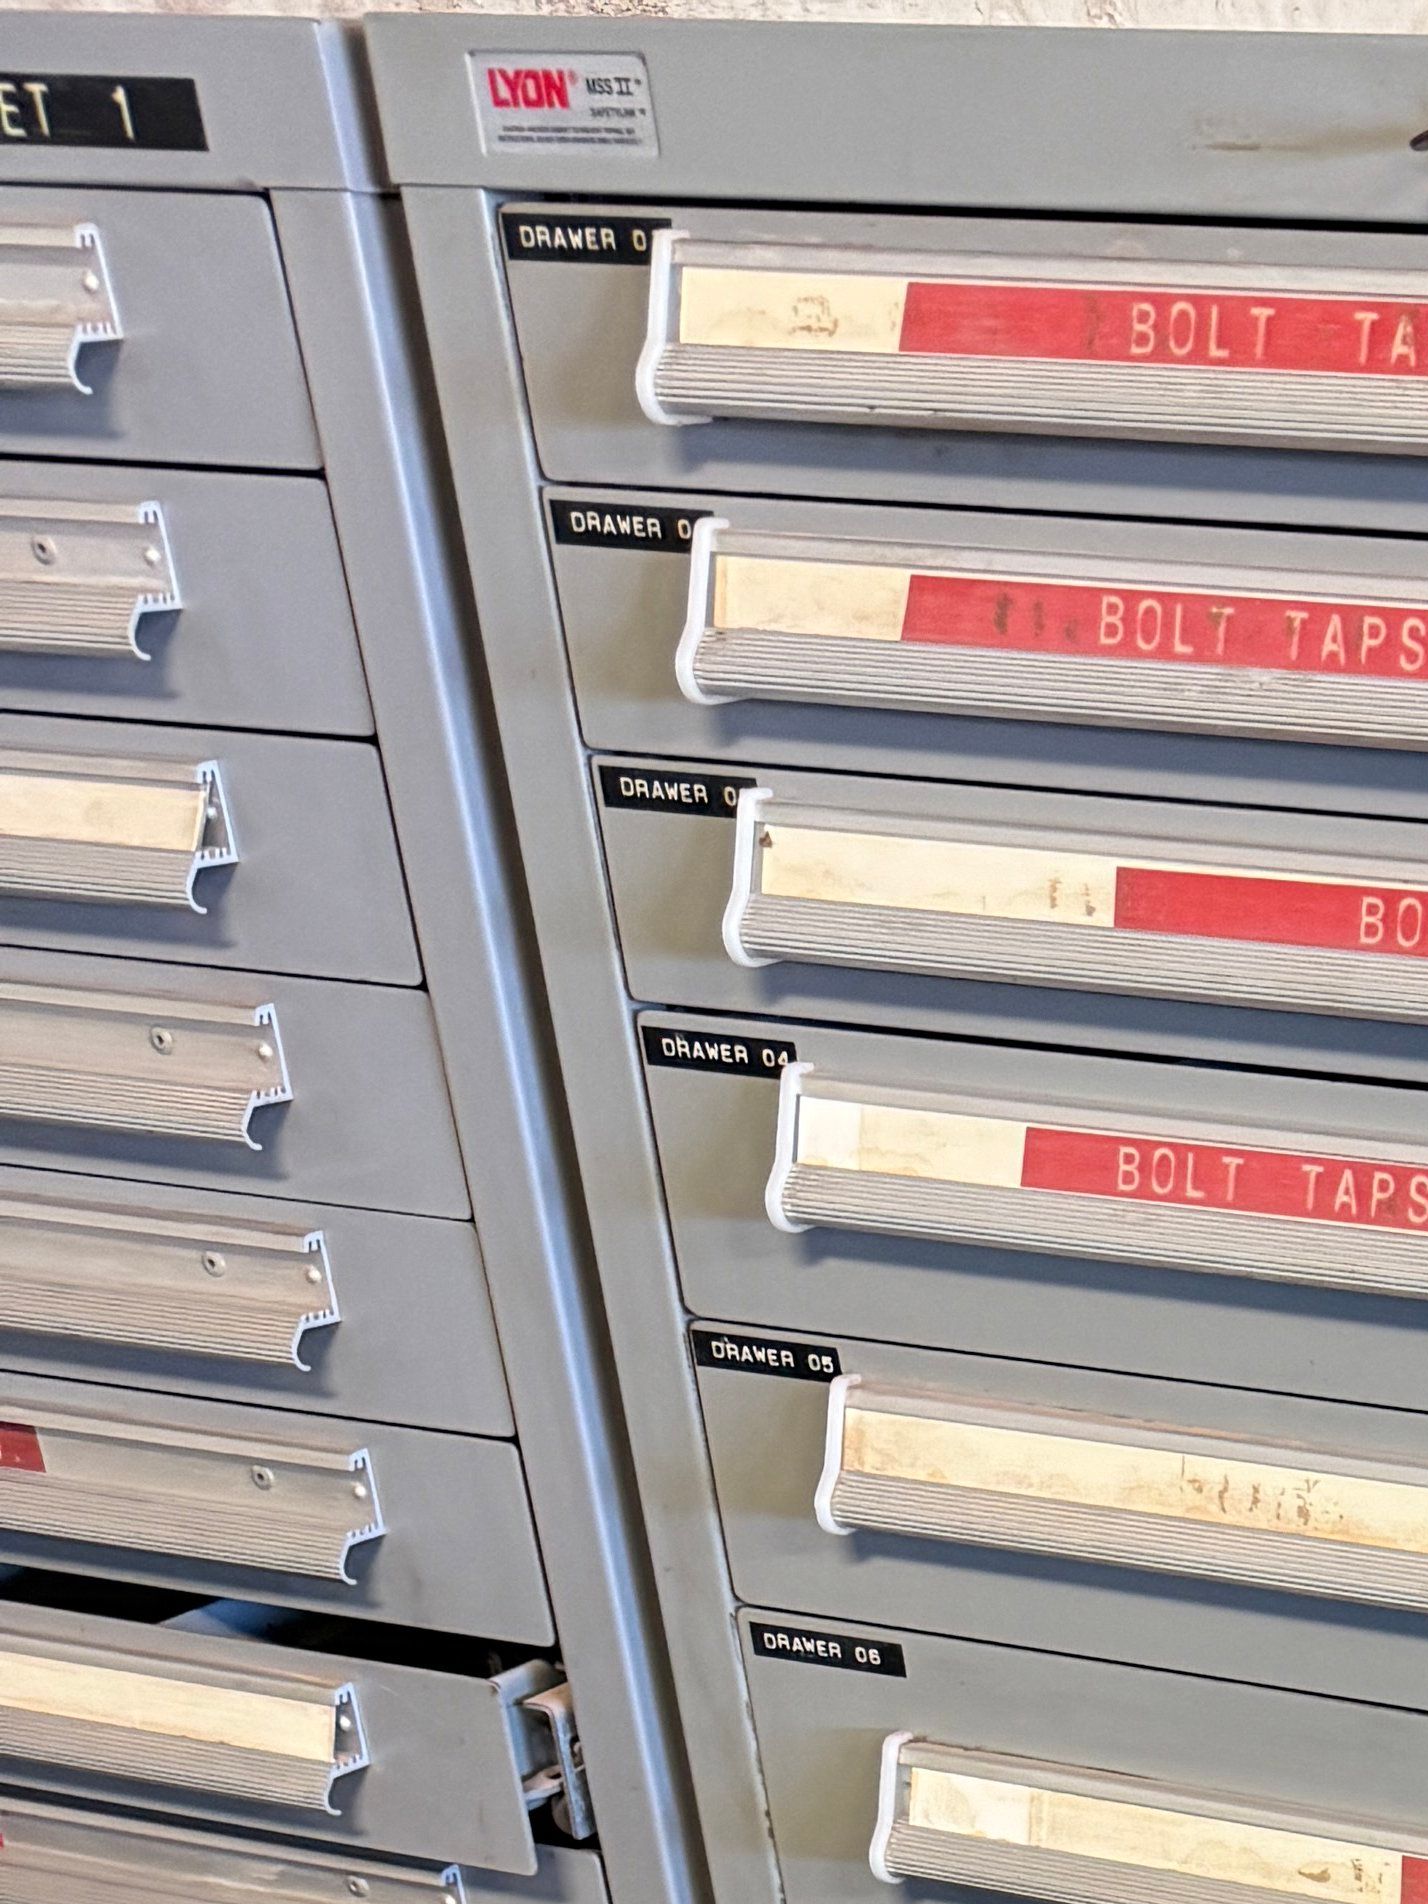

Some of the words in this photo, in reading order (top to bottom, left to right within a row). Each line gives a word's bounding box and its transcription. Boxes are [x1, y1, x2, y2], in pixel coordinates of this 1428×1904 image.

[487, 67, 570, 109] LYON
[0, 82, 49, 138] ET
[111, 84, 136, 143] 1
[518, 225, 616, 251] DRAWER
[632, 230, 648, 251] 0
[1129, 301, 1275, 360] BOLT
[570, 511, 662, 540] DRAWER
[677, 520, 693, 541] 0
[1100, 595, 1235, 656] BOLT
[1284, 609, 1428, 672] TAPS
[620, 776, 709, 804] DRAWER
[661, 1036, 749, 1065] DRAWER
[762, 1048, 790, 1068] 04
[1116, 1145, 1245, 1202] BOLT
[710, 1338, 796, 1369] DRAWER
[807, 1352, 835, 1375] 05
[763, 1631, 843, 1660] DRAWER
[854, 1645, 882, 1667] 06
